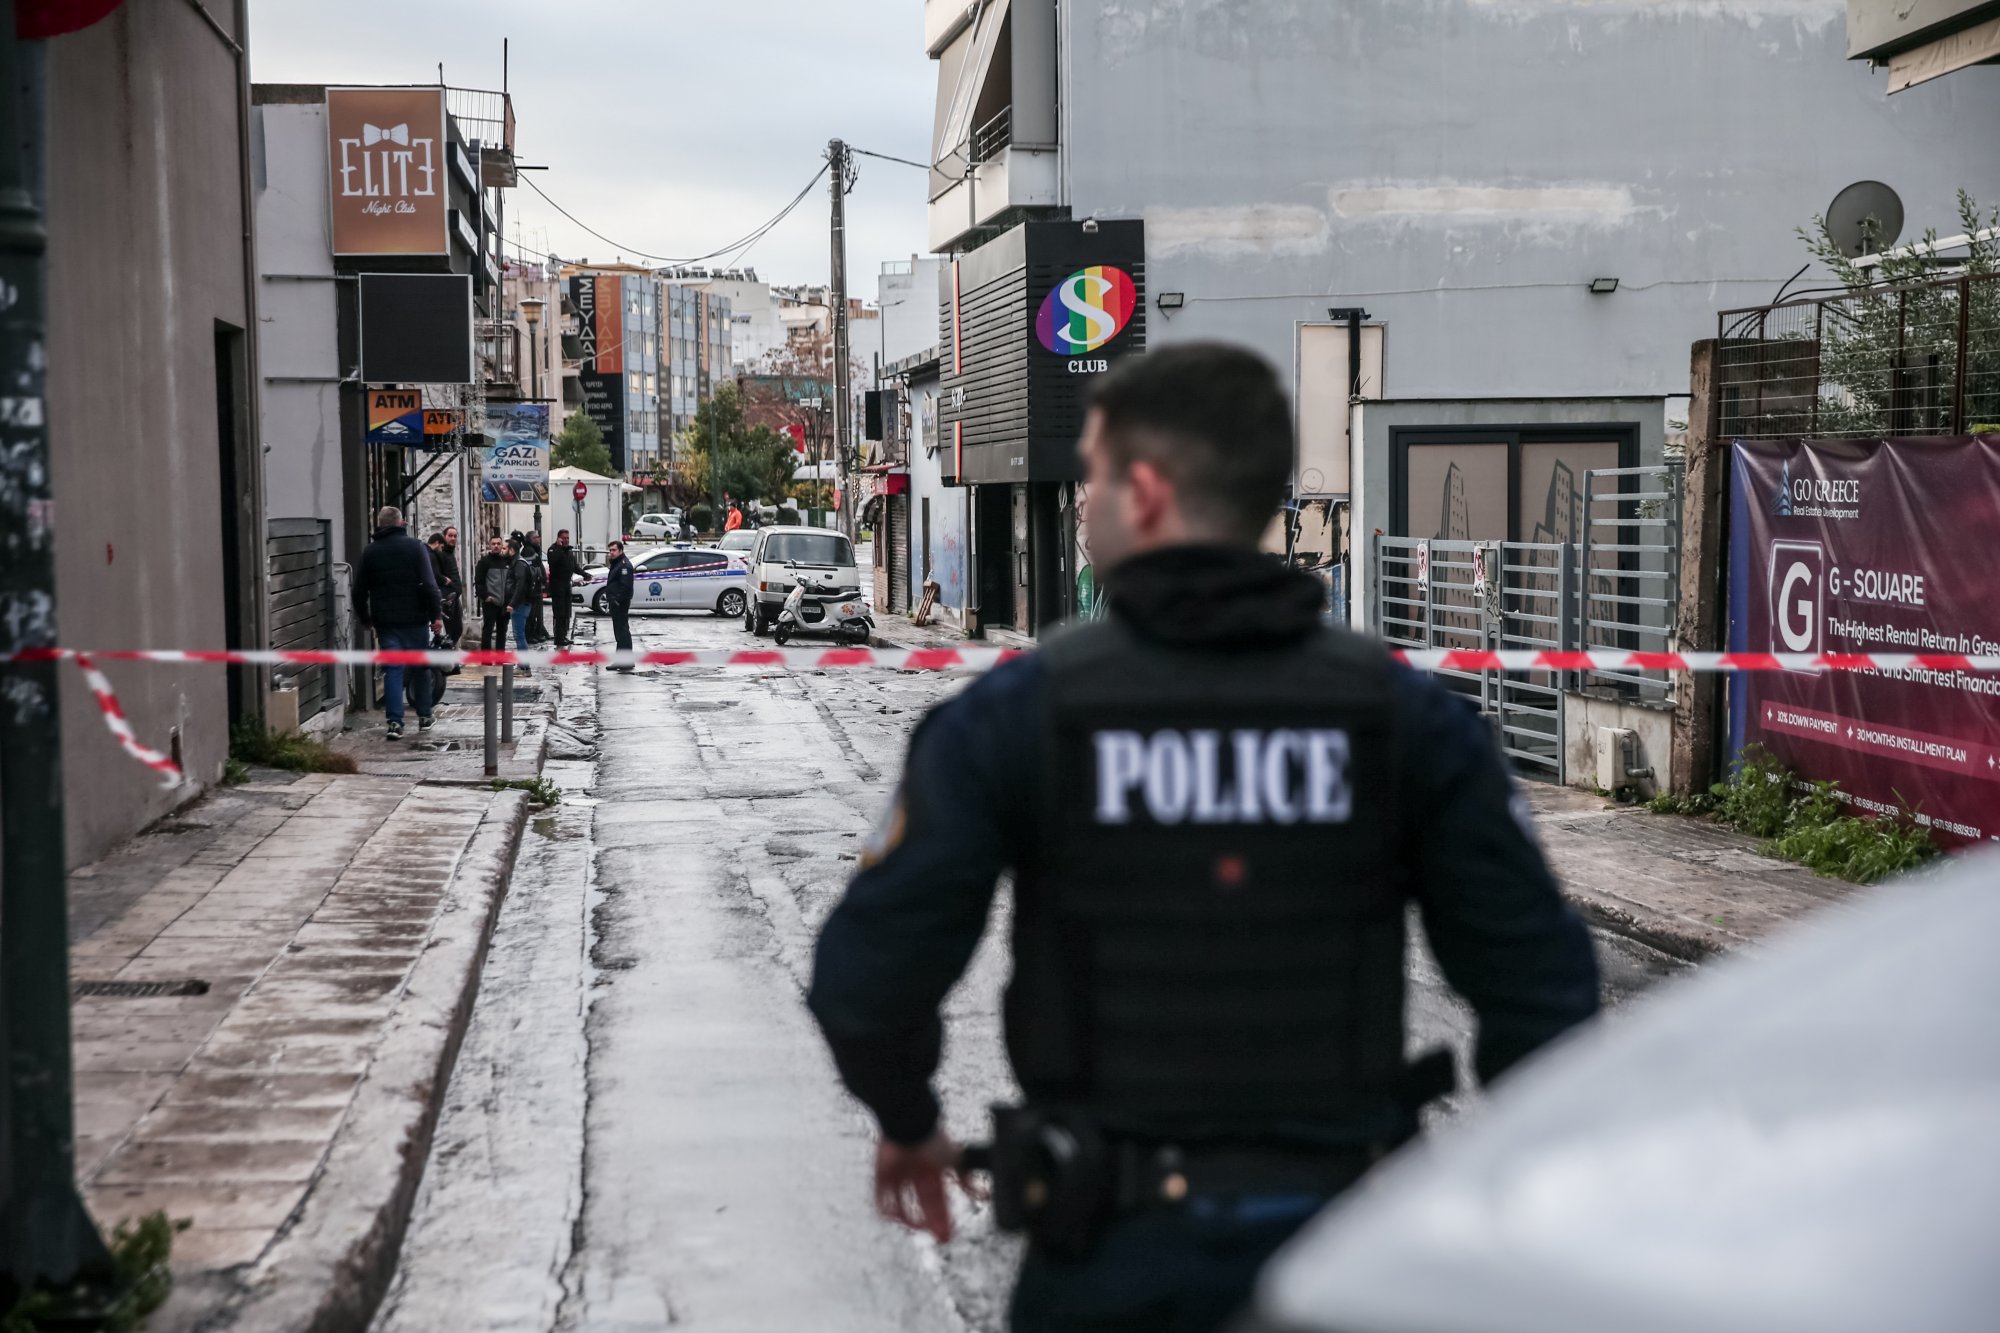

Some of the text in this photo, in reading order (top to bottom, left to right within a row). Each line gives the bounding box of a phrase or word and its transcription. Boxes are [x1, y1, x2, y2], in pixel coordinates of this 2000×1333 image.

[339, 138, 435, 196] ELITE
[362, 200, 416, 216] Night Club
[1057, 275, 1115, 345] S
[1067, 360, 1108, 373] CLUB
[375, 395, 415, 408] ATM
[495, 447, 536, 458] GAZI
[496, 458, 540, 467] PARKING
[1794, 479, 1859, 503] GO GREECE
[1794, 506, 1858, 520] Real Estate Development
[1778, 561, 1813, 651] G
[1828, 617, 2000, 657] The Highest Rental Return In Gree
[1883, 664, 1902, 679] and
[1904, 666, 1955, 688] Smartest
[1789, 713, 1809, 728] DOWN
[1809, 717, 1837, 735] PAYMENT
[1856, 728, 1967, 762] 30 MONTHS INSTALLMENT PLAN
[1093, 728, 1351, 824] POLICE
